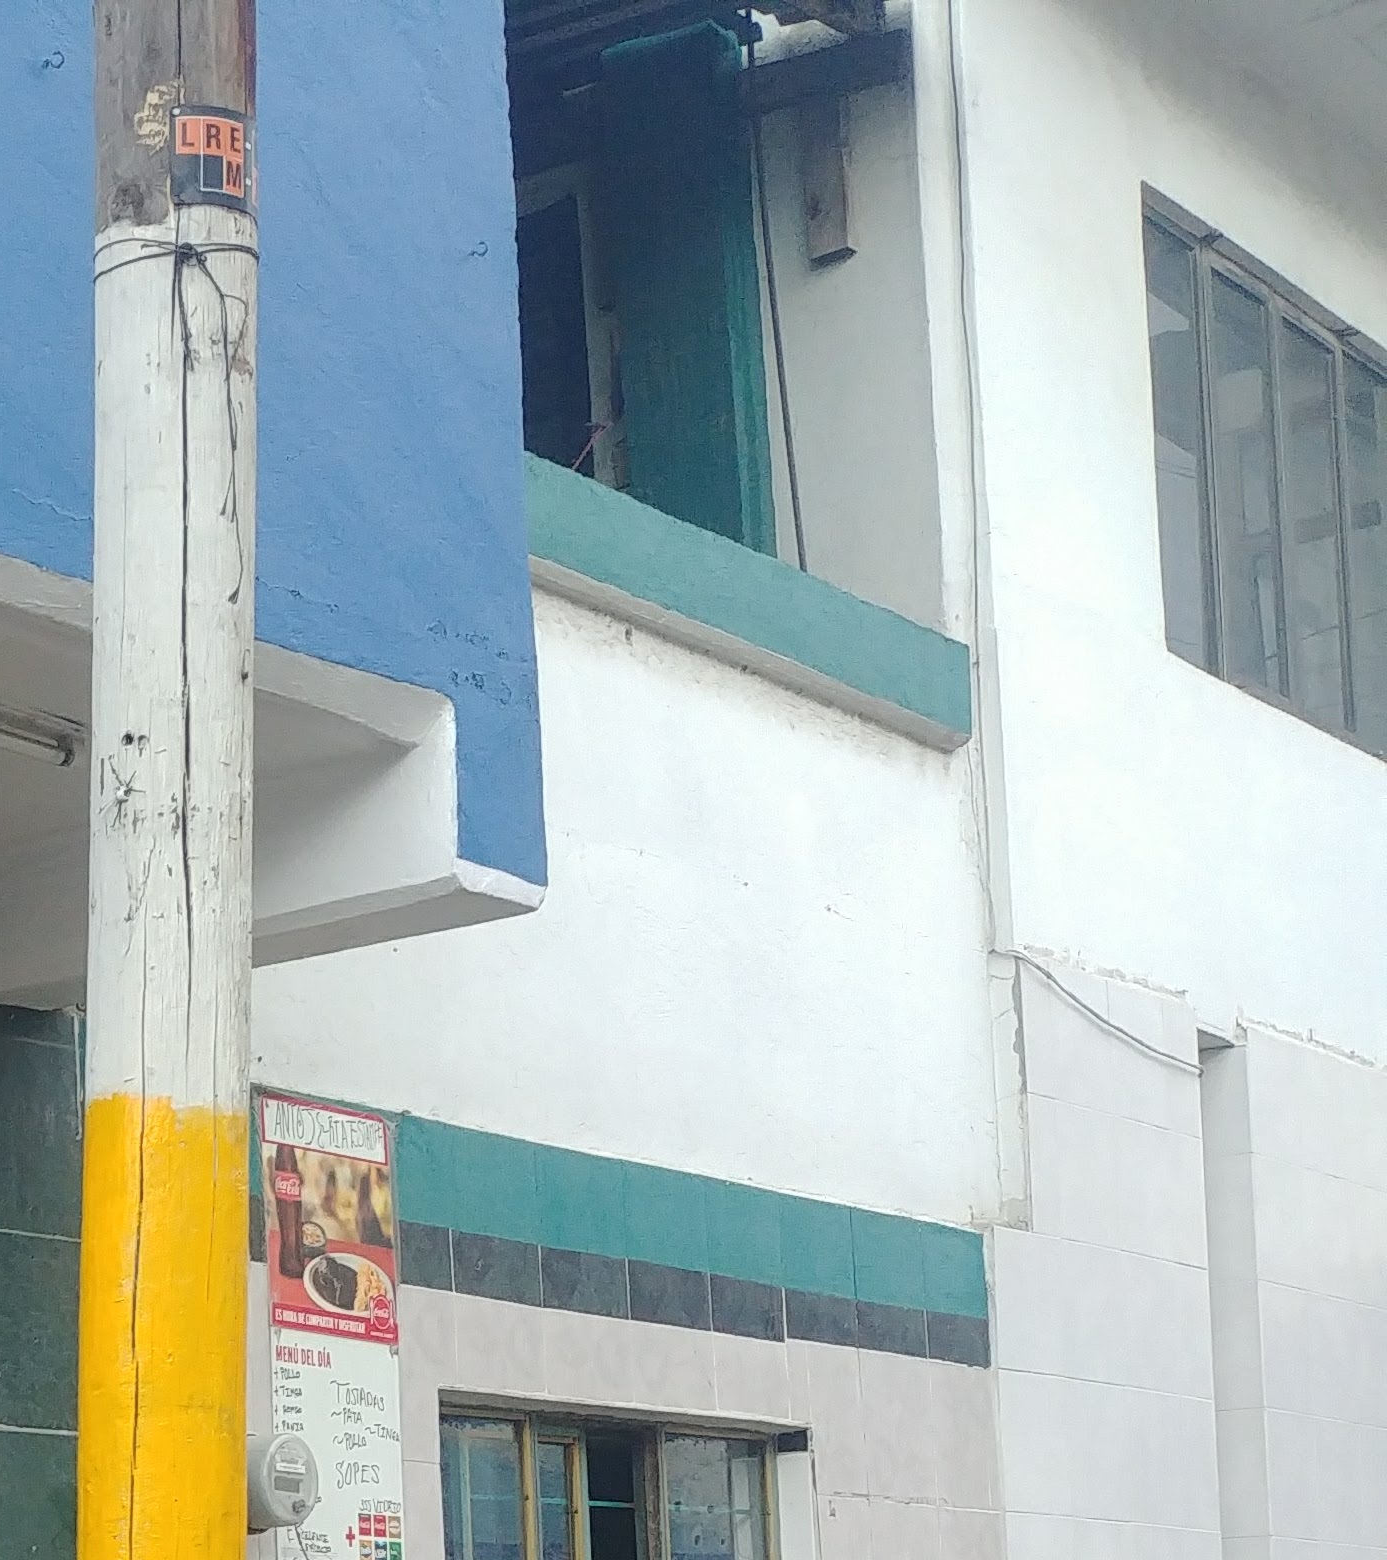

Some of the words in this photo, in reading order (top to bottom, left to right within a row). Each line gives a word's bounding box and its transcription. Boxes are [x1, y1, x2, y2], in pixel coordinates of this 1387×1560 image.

[226, 160, 242, 190] M
[275, 1343, 299, 1364] MENÚ
[301, 1348, 316, 1367] DEL
[318, 1346, 331, 1369] DÍA
[336, 1461, 380, 1489] SOPES
